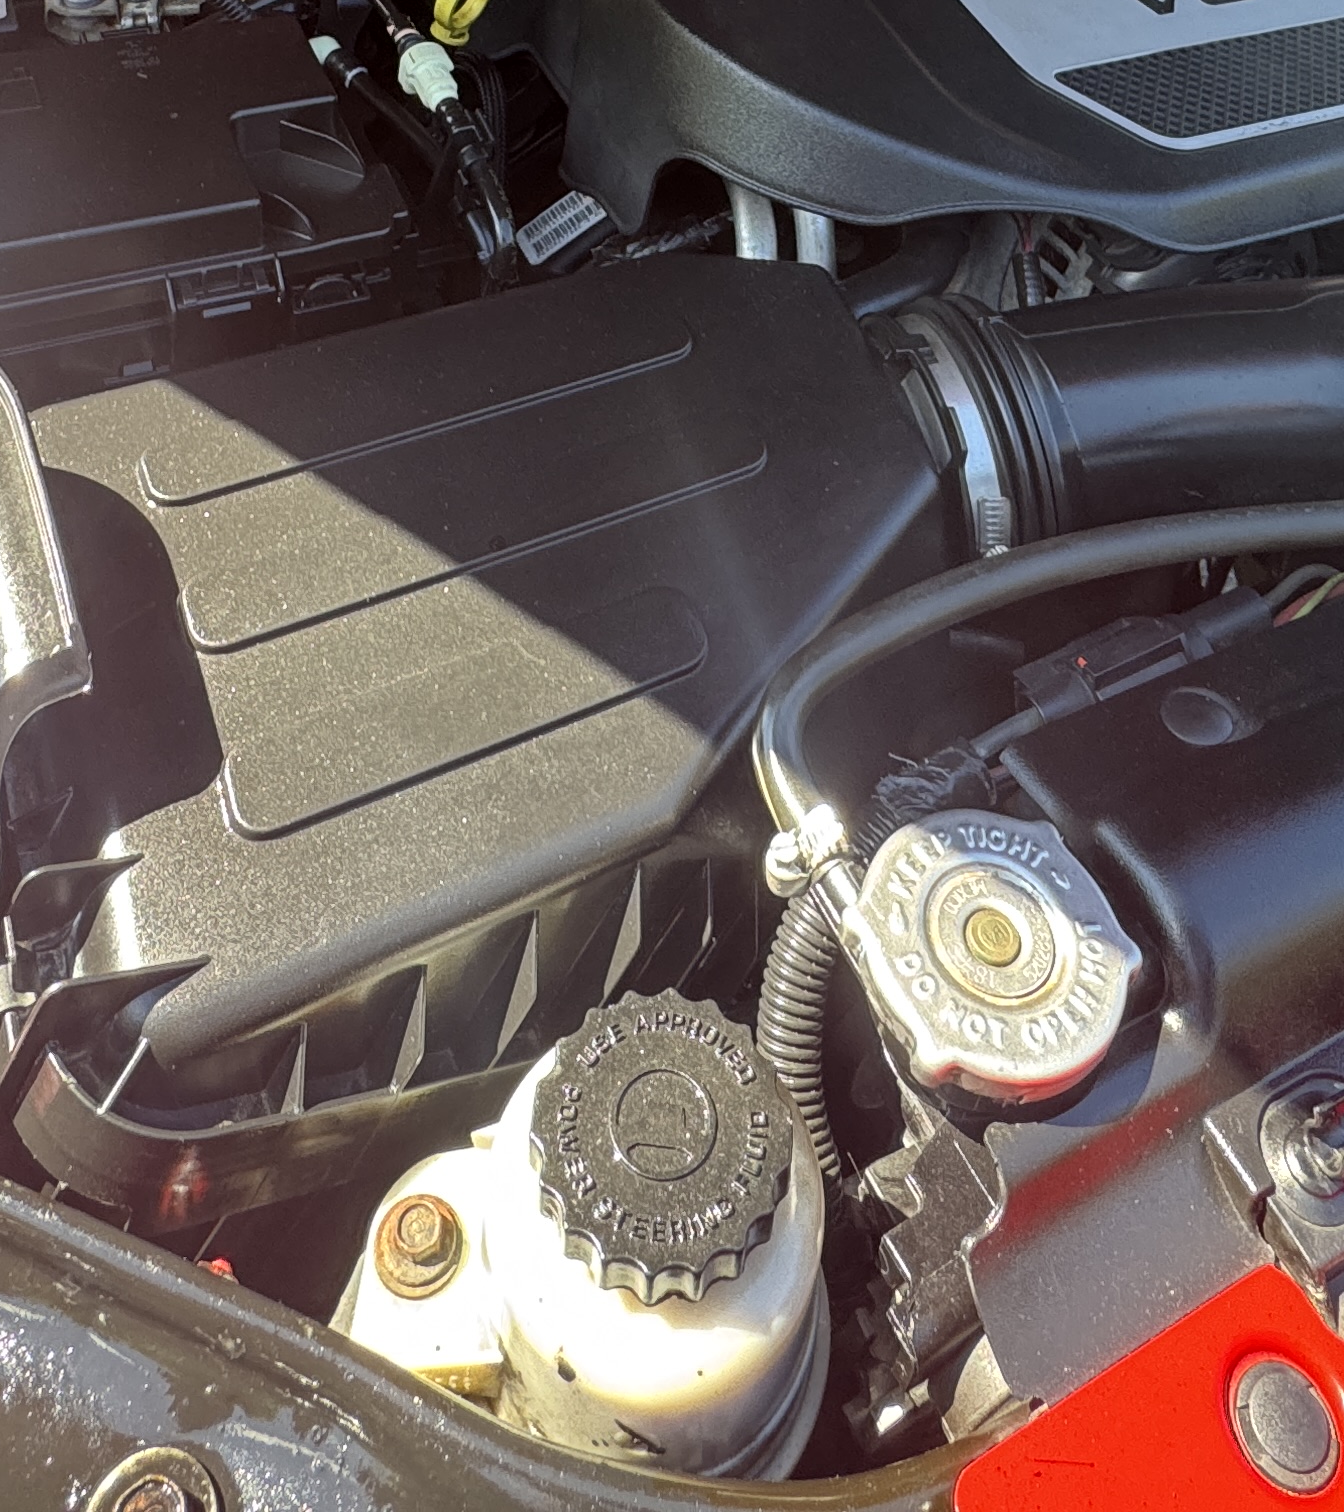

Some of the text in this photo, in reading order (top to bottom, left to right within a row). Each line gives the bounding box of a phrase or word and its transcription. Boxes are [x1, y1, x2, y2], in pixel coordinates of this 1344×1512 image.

[887, 825, 1050, 900] KEEP TIGHT
[893, 951, 938, 1002] DO
[938, 997, 1008, 1050] NOT
[1020, 984, 1098, 1056] OPEN
[1074, 919, 1108, 986] HOT
[575, 1010, 757, 1086] USE APPROVED
[557, 1082, 770, 1244] POWER STEERING FLUID
